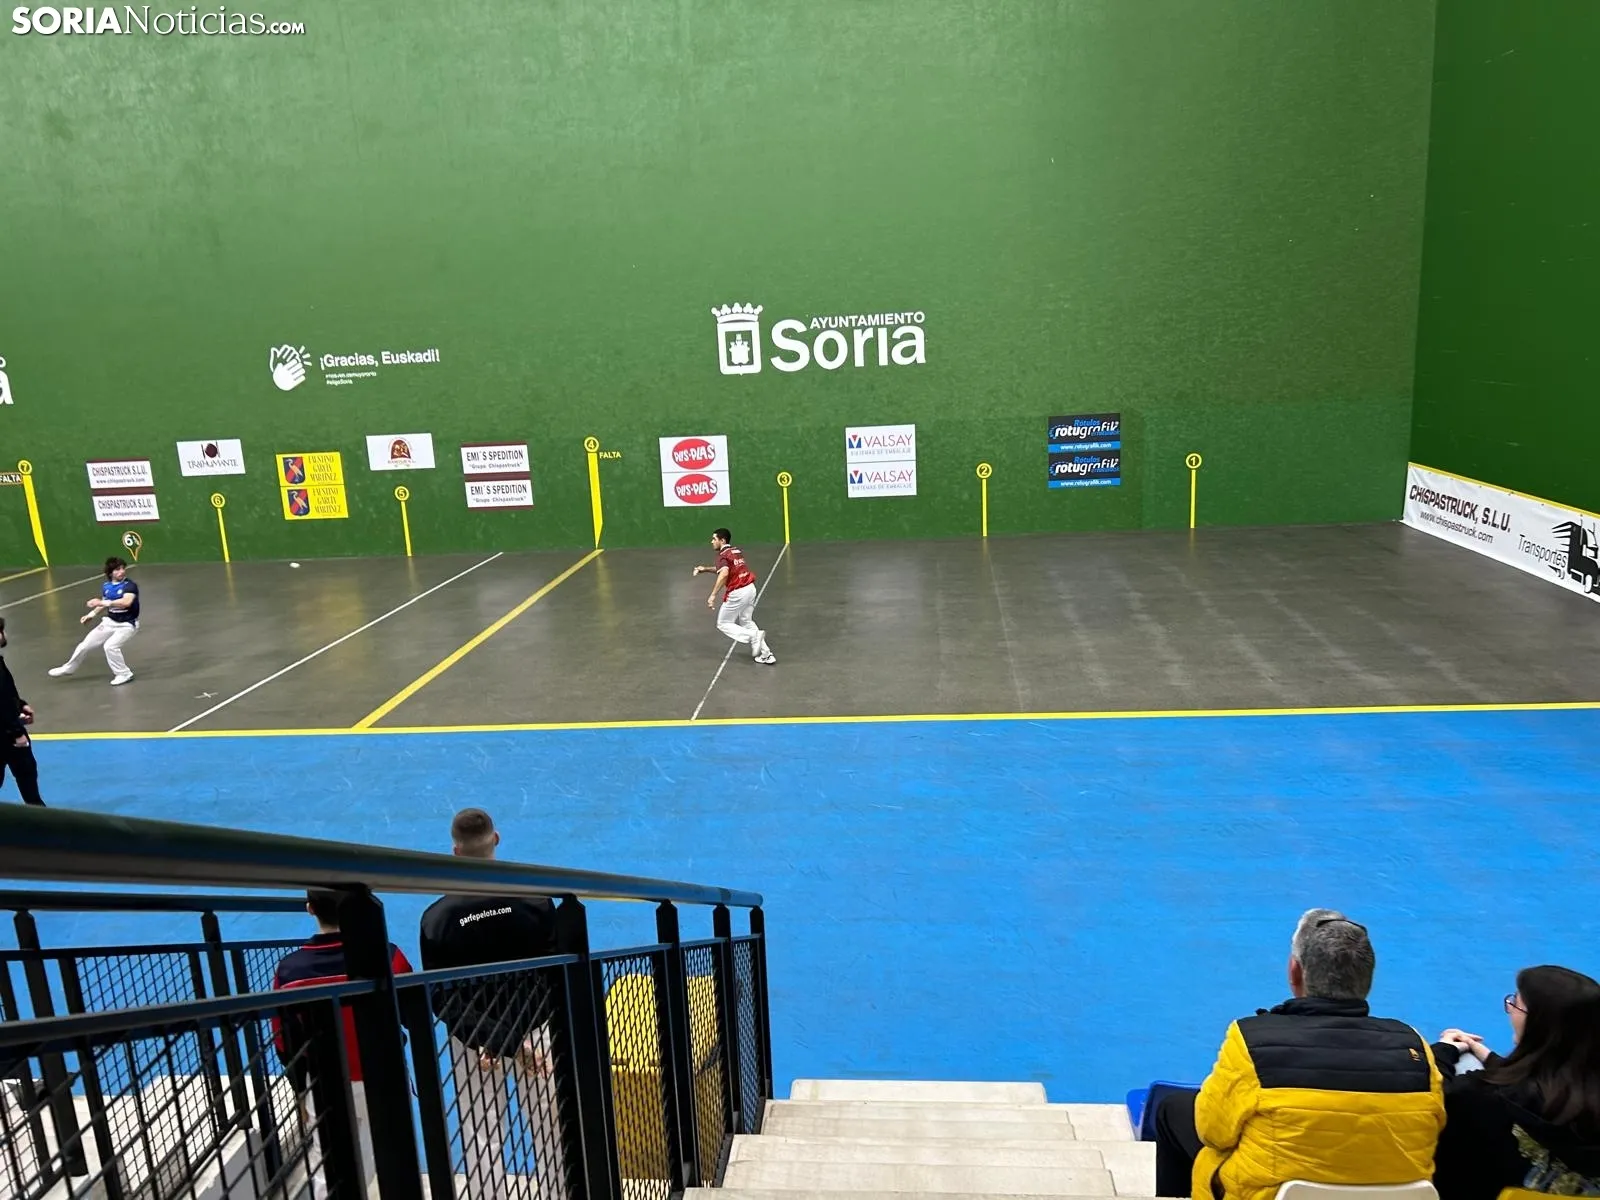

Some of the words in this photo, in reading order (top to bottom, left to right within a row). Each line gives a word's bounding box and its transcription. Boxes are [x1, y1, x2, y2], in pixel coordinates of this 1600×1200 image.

[810, 311, 925, 329] AYUNTAMIENTO
[770, 319, 926, 372] Soria
[320, 353, 379, 370] ¡Gracias,
[381, 349, 440, 364] Euskadi!
[863, 434, 912, 448] VALSAY
[488, 449, 524, 460] SPEDITION
[599, 449, 621, 459] FALTA
[92, 465, 132, 476] CHISPASTRUCK
[131, 464, 148, 475] S.L.U.
[865, 470, 913, 483] VALSAY
[492, 484, 527, 494] SPEDITION
[98, 499, 137, 509] CHISPASTRUCK
[137, 498, 154, 508] S.L.U.
[1409, 484, 1479, 524] CHISPASTRUCK,
[1481, 507, 1511, 533] S.L.U.
[1420, 510, 1494, 544] www.chispastruck.com
[1518, 534, 1567, 568] Transportes
[459, 906, 512, 927] garfepelota.com
